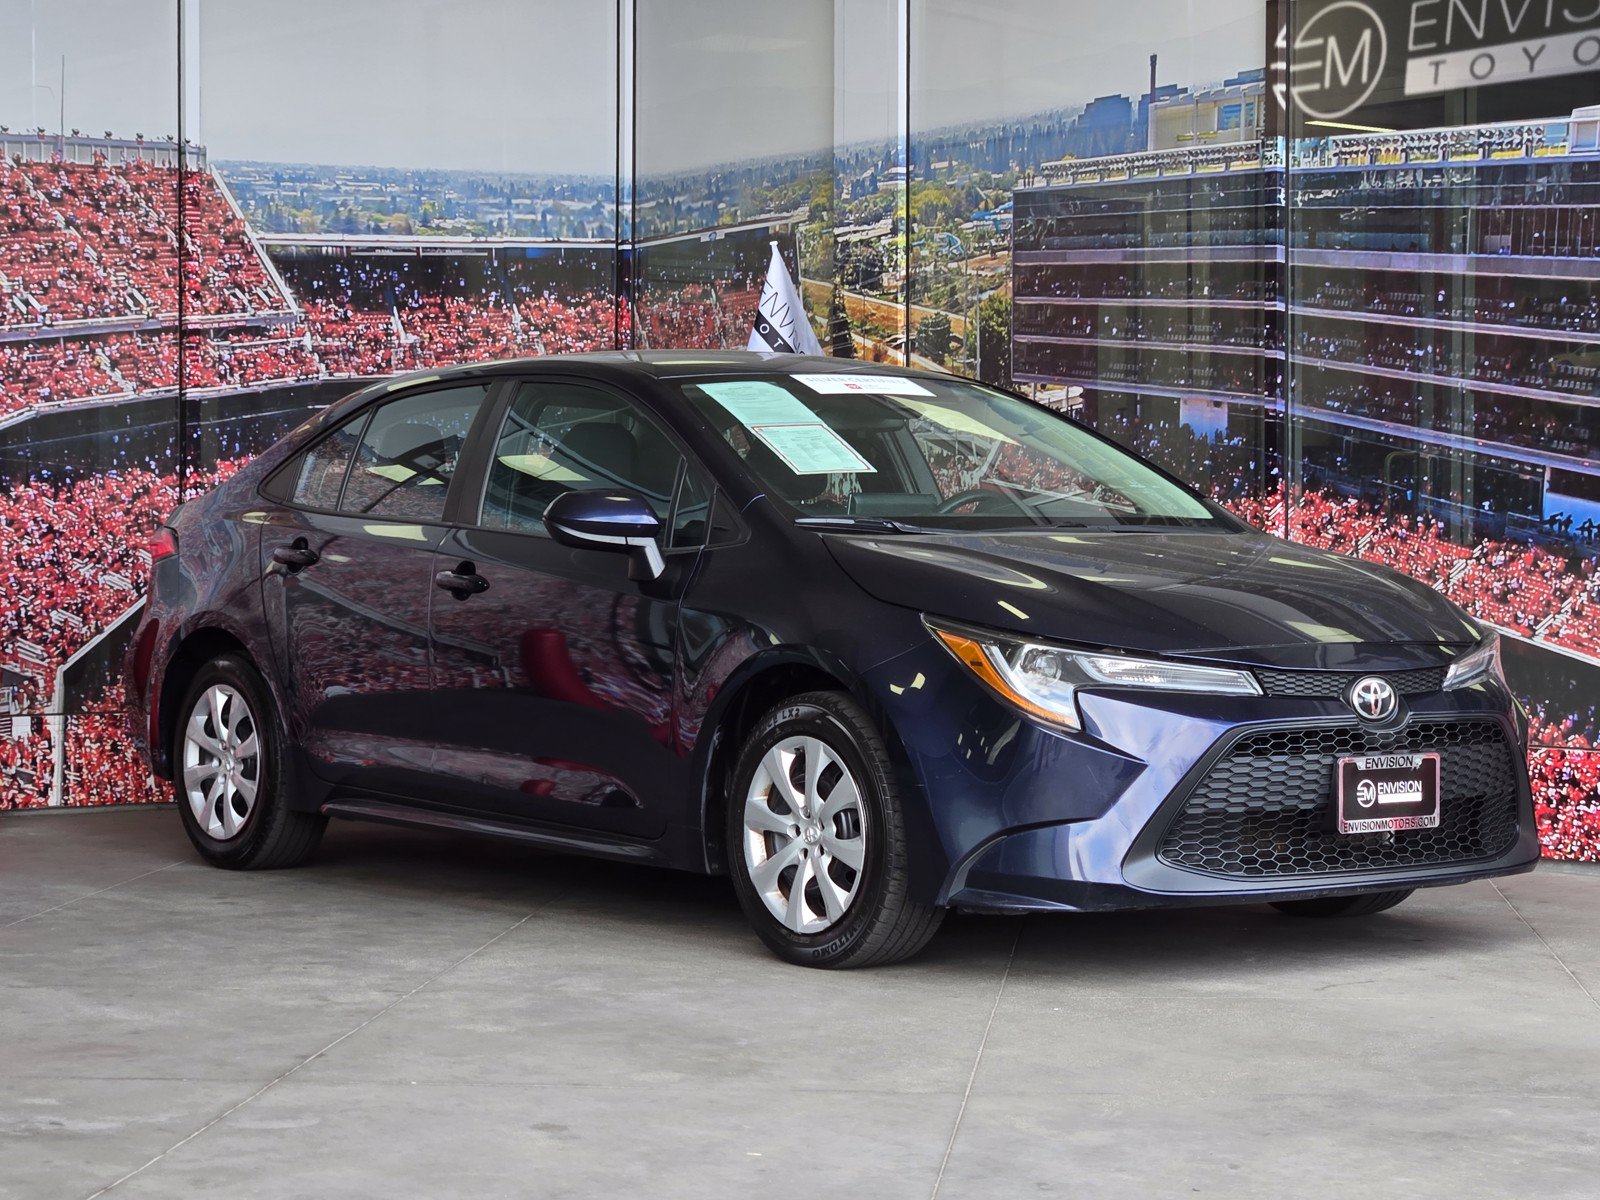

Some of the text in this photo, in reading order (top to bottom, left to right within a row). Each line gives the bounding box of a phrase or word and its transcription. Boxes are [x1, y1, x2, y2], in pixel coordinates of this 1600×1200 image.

[1364, 755, 1414, 769] ENVISION
[1377, 780, 1422, 794] ENVISION
[1343, 816, 1437, 833] ENVISIONMOTORS.COM
